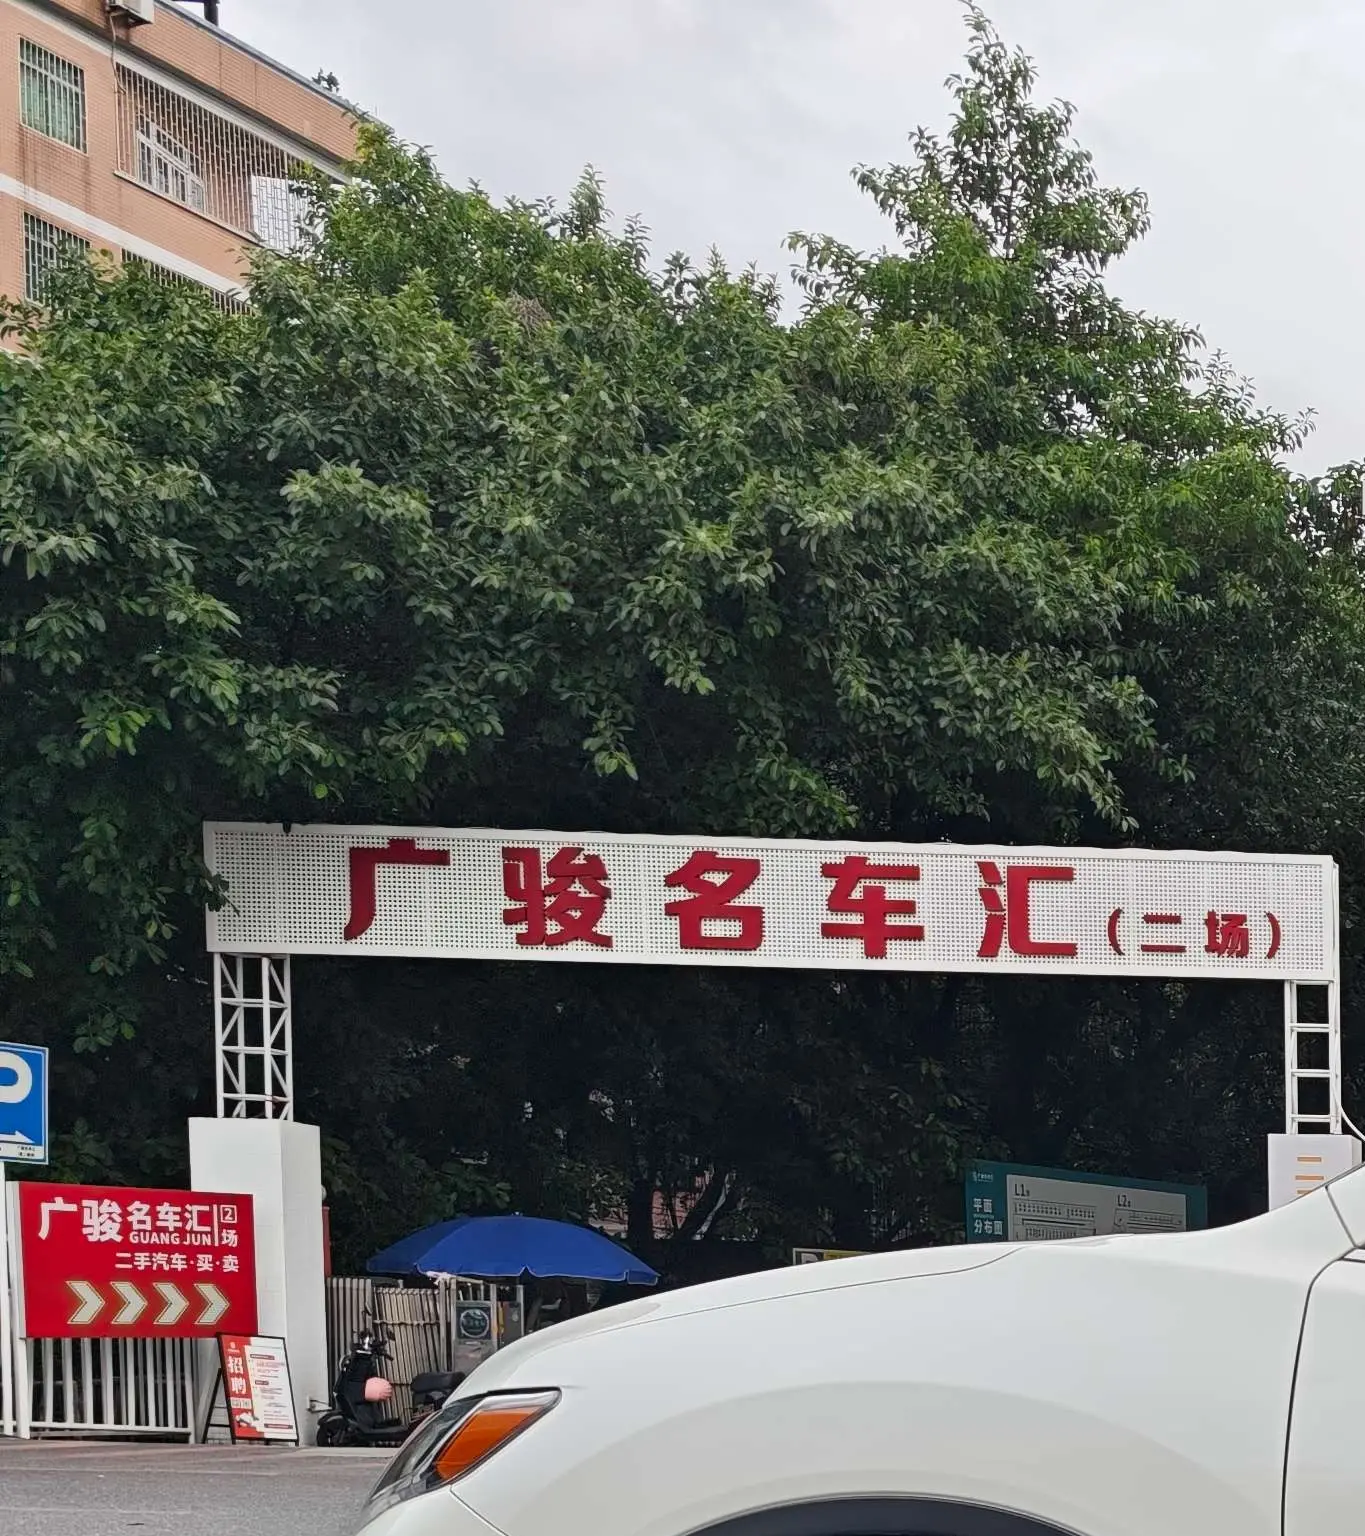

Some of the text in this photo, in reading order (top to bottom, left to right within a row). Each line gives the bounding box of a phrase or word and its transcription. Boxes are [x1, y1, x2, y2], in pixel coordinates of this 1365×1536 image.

[38, 1196, 211, 1243] 广骏名车汇
[129, 1230, 212, 1247] GUANG JUN
